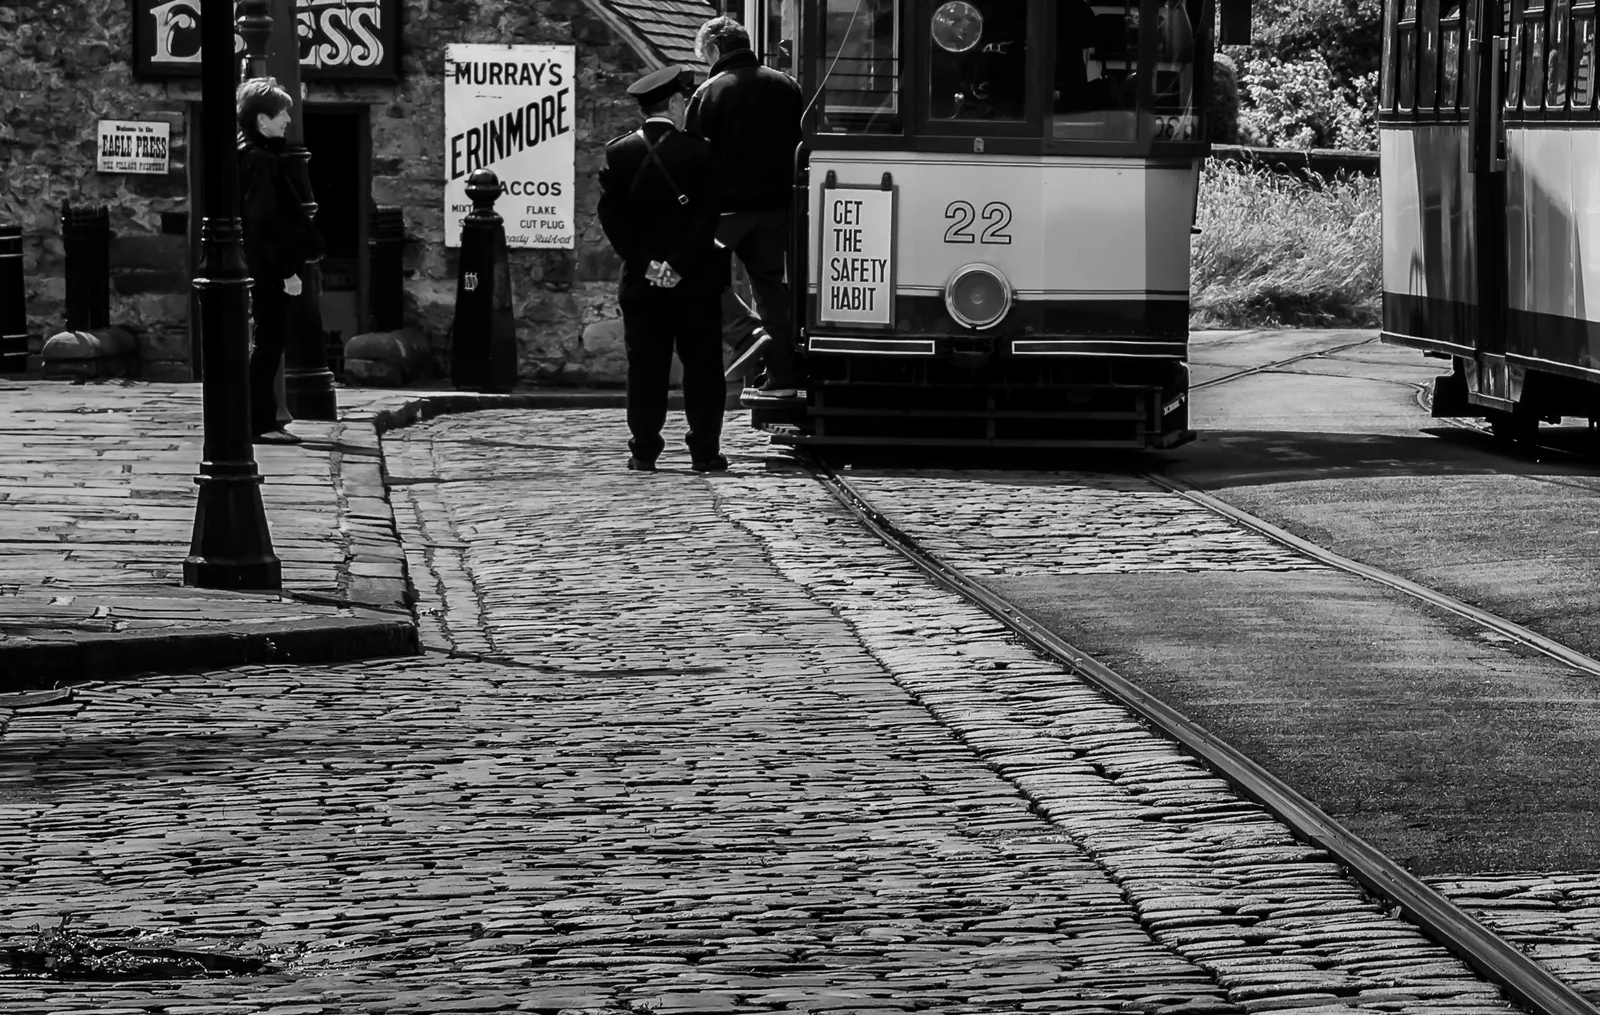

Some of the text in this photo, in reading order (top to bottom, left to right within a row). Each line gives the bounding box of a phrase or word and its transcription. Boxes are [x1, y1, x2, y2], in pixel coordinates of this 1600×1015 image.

[455, 58, 563, 86] MURRAY'S
[102, 134, 167, 160] EAGLE PRESS
[451, 87, 570, 181] ERINMORE
[526, 206, 557, 216] FLAKE
[833, 199, 863, 226] GET
[943, 200, 1012, 245] 22
[520, 219, 565, 230] CUT PLUG
[833, 228, 863, 253] THE
[830, 257, 888, 283] SAFETY
[831, 286, 877, 311] HABIT
